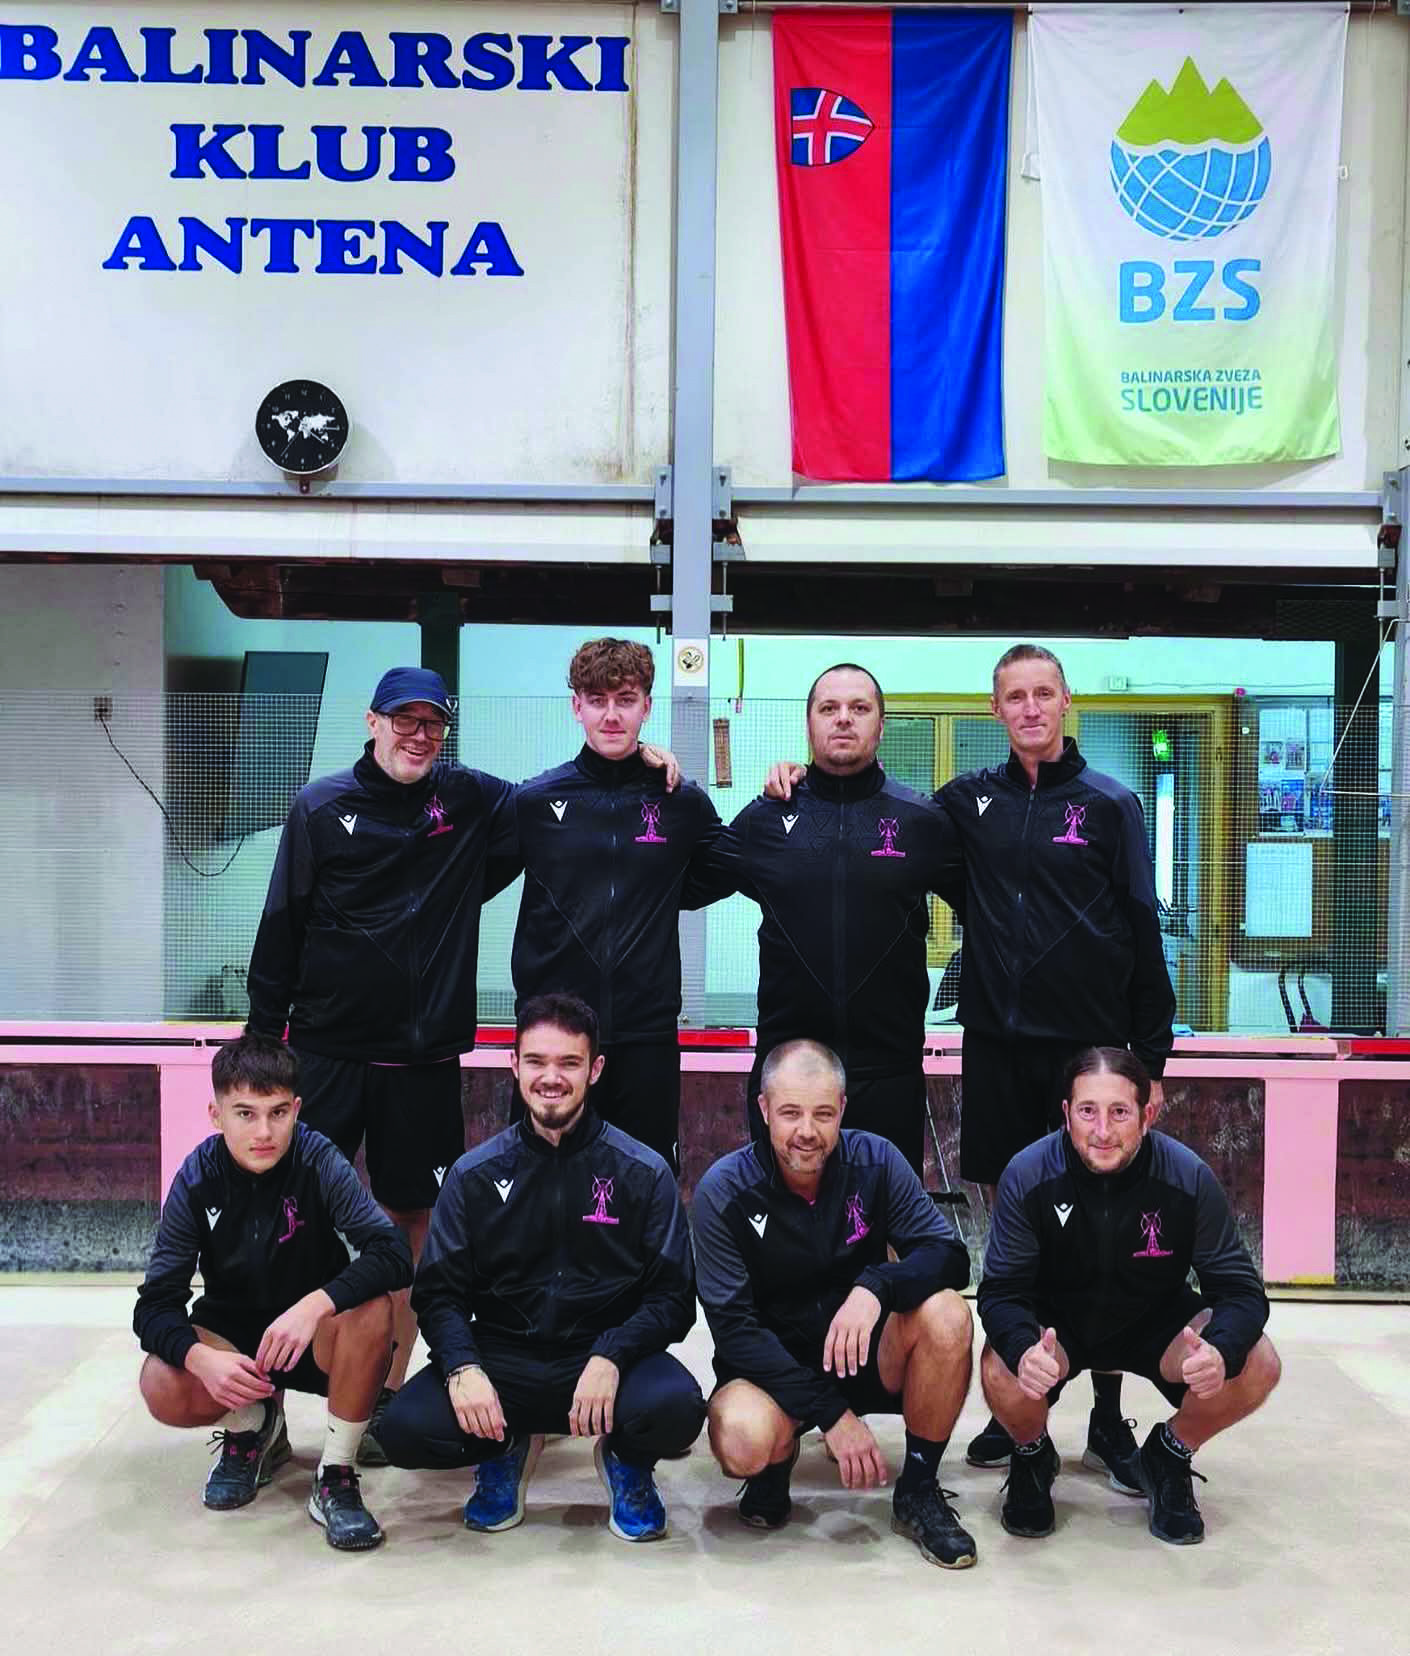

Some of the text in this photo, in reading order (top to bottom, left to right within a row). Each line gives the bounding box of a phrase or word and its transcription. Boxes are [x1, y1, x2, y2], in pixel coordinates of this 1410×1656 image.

[0, 24, 631, 92] BALINARSKI
[169, 123, 456, 182] KLUB
[102, 216, 524, 277] ANTENA
[1120, 259, 1261, 323] BZS
[1120, 368, 1262, 384] BALINARSKA ZVEZA
[1121, 386, 1263, 415] SLOVENIJE
